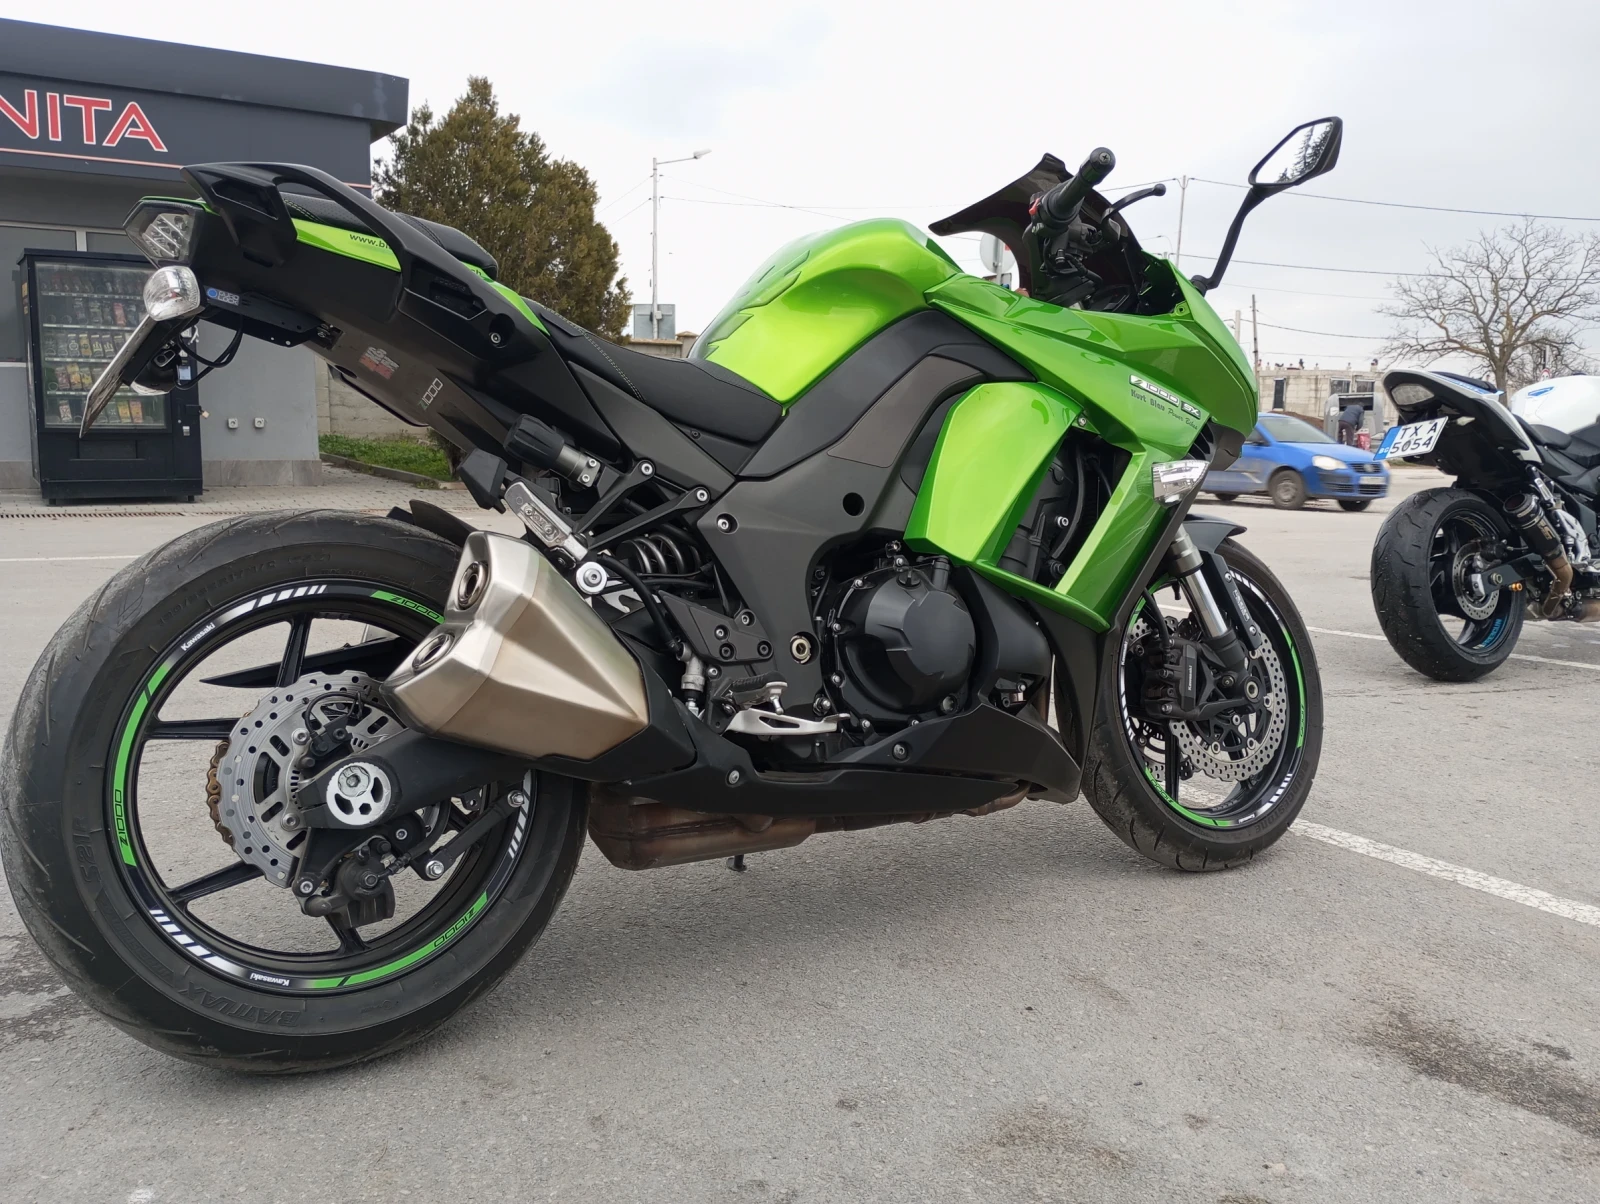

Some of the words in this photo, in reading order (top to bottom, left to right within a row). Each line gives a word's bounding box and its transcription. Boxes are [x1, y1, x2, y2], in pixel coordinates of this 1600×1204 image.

[1182, 401, 1201, 418] SX
[1400, 425, 1423, 440] TX
[1427, 421, 1438, 435] A
[1378, 446, 1390, 454] BG
[1389, 436, 1433, 455] 5054
[180, 621, 216, 651] Kawasaki
[249, 972, 290, 987] Kawasaki
